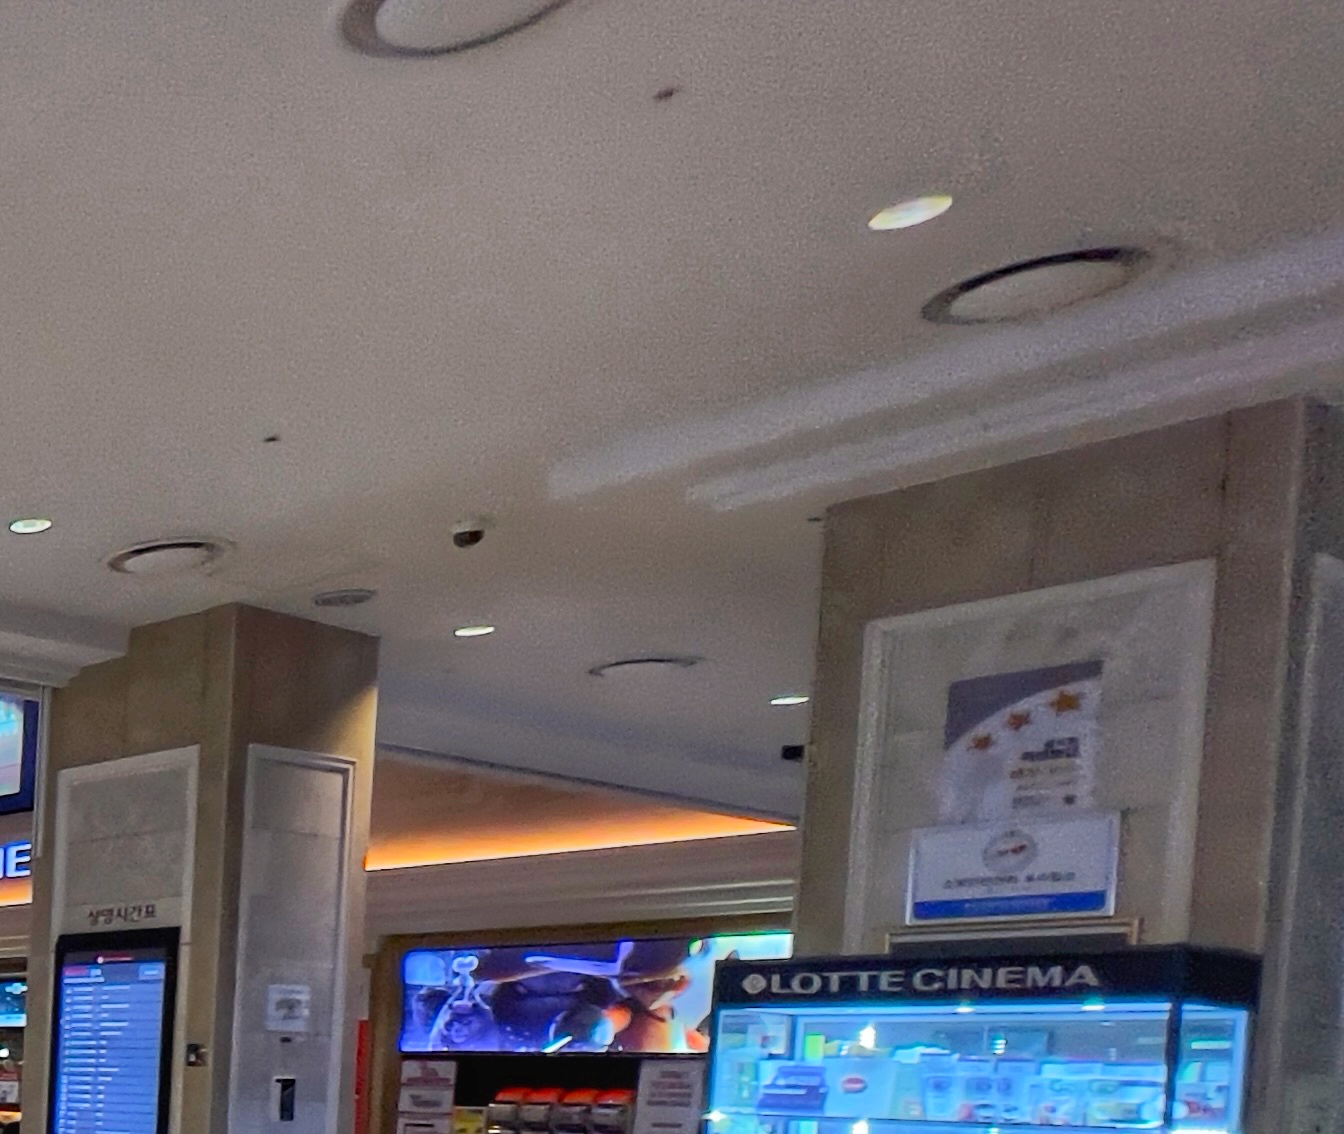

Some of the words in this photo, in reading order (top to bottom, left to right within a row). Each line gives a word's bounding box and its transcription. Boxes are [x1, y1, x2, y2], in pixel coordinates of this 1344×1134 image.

[86, 905, 158, 925] 상영시간표
[769, 970, 905, 995] LOTTE
[912, 965, 1101, 993] CINEMA
